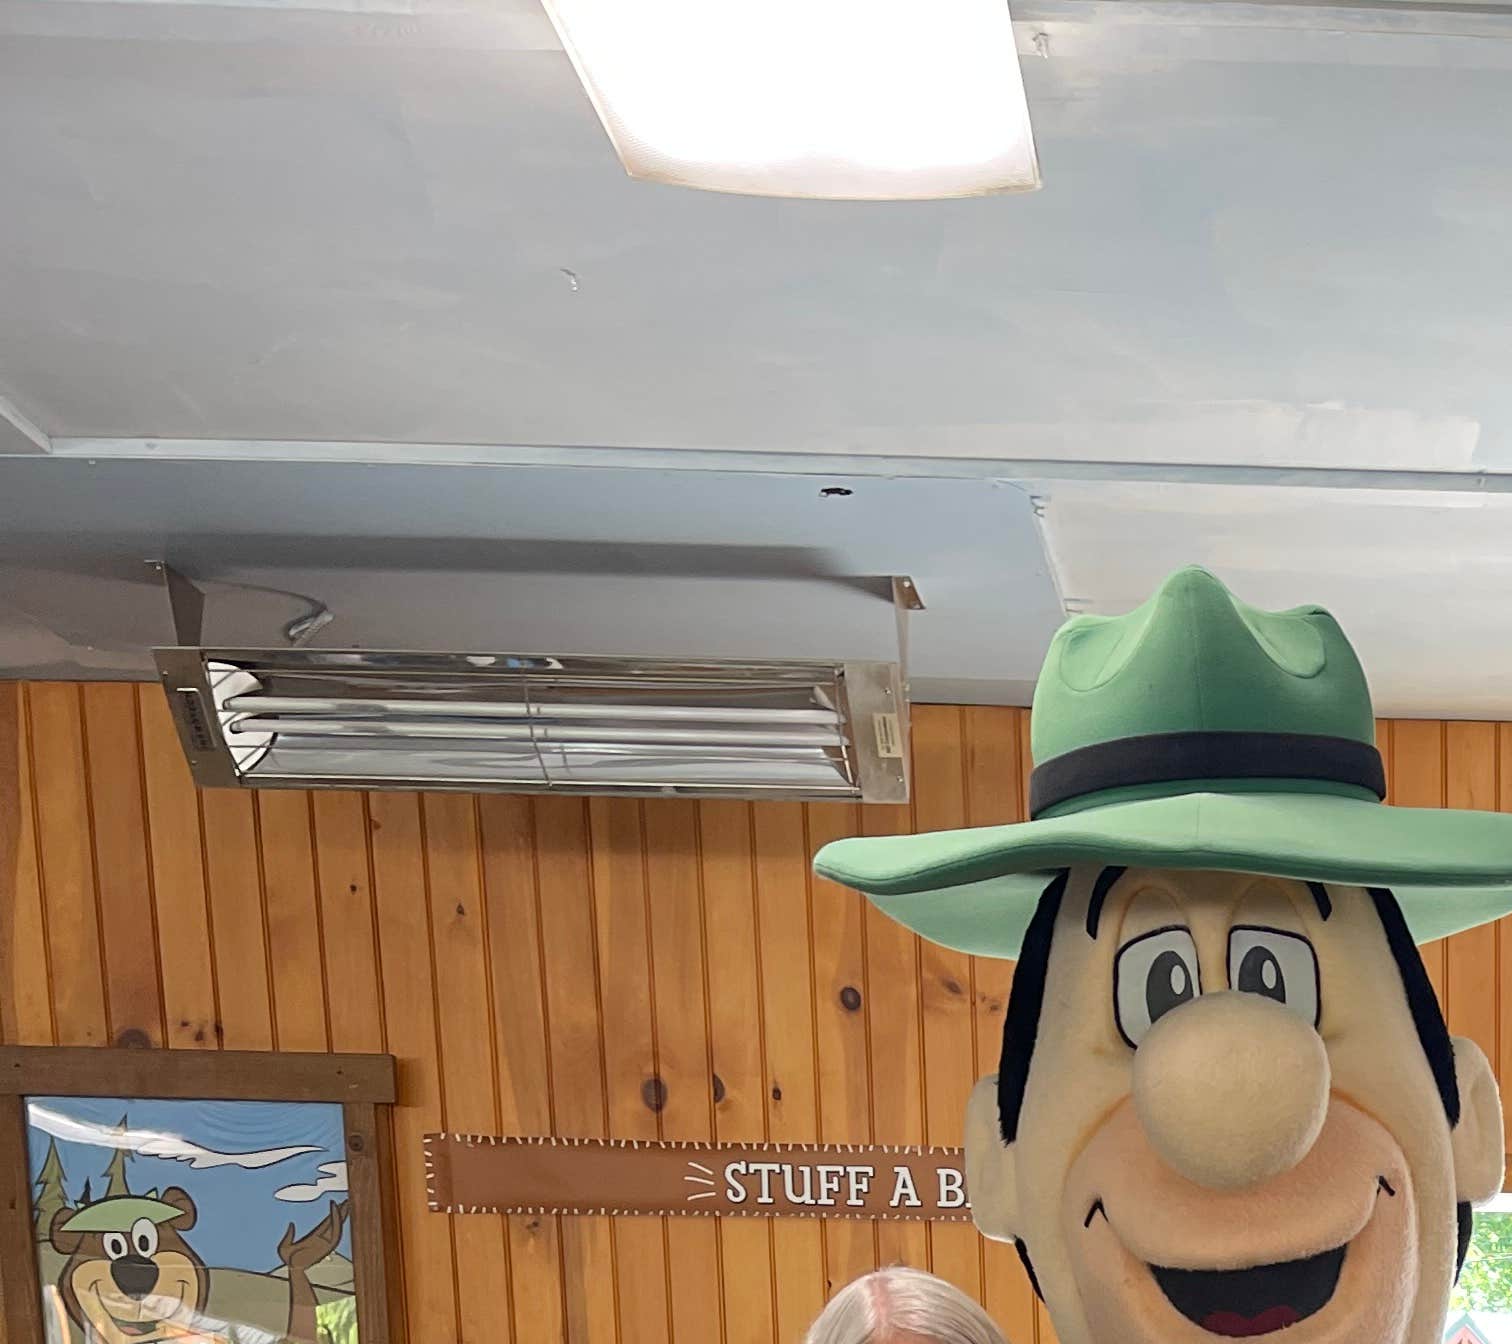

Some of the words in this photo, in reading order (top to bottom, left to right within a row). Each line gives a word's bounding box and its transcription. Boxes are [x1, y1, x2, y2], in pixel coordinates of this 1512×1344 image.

[724, 1160, 873, 1207] STUFF
[889, 1166, 922, 1207] A
[936, 1168, 974, 1208] B
